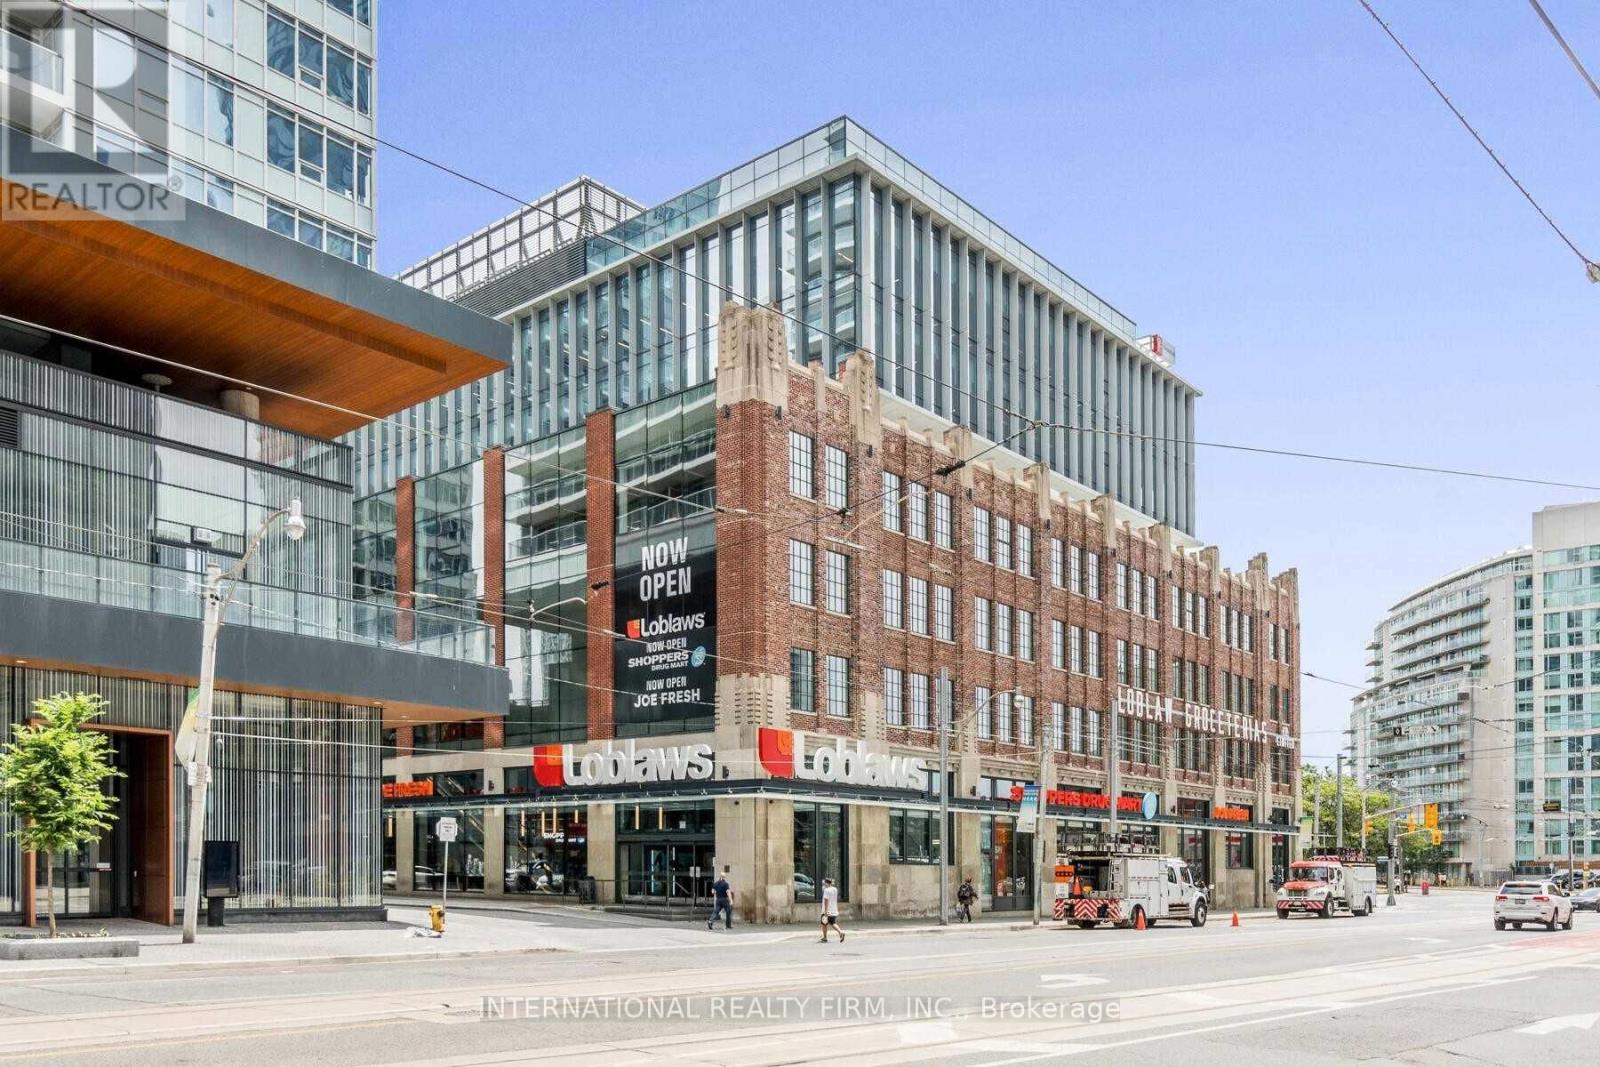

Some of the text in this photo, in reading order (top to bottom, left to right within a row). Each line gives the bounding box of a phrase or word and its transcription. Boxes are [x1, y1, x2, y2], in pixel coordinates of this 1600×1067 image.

[641, 537, 689, 571] NOW
[639, 567, 692, 602] OPEN
[641, 612, 705, 637] Loblaws
[646, 637, 687, 654] NOW OPEN
[628, 650, 689, 669] SHOPPERS
[670, 660, 689, 669] MART
[646, 676, 687, 691] NOW OPEN
[634, 687, 701, 708] JOE FRESH
[1117, 686, 1173, 724] LOBLAW
[1185, 702, 1268, 744] GROCETERIAS
[563, 739, 715, 786] Loblaws
[792, 731, 928, 790] Loblaws
